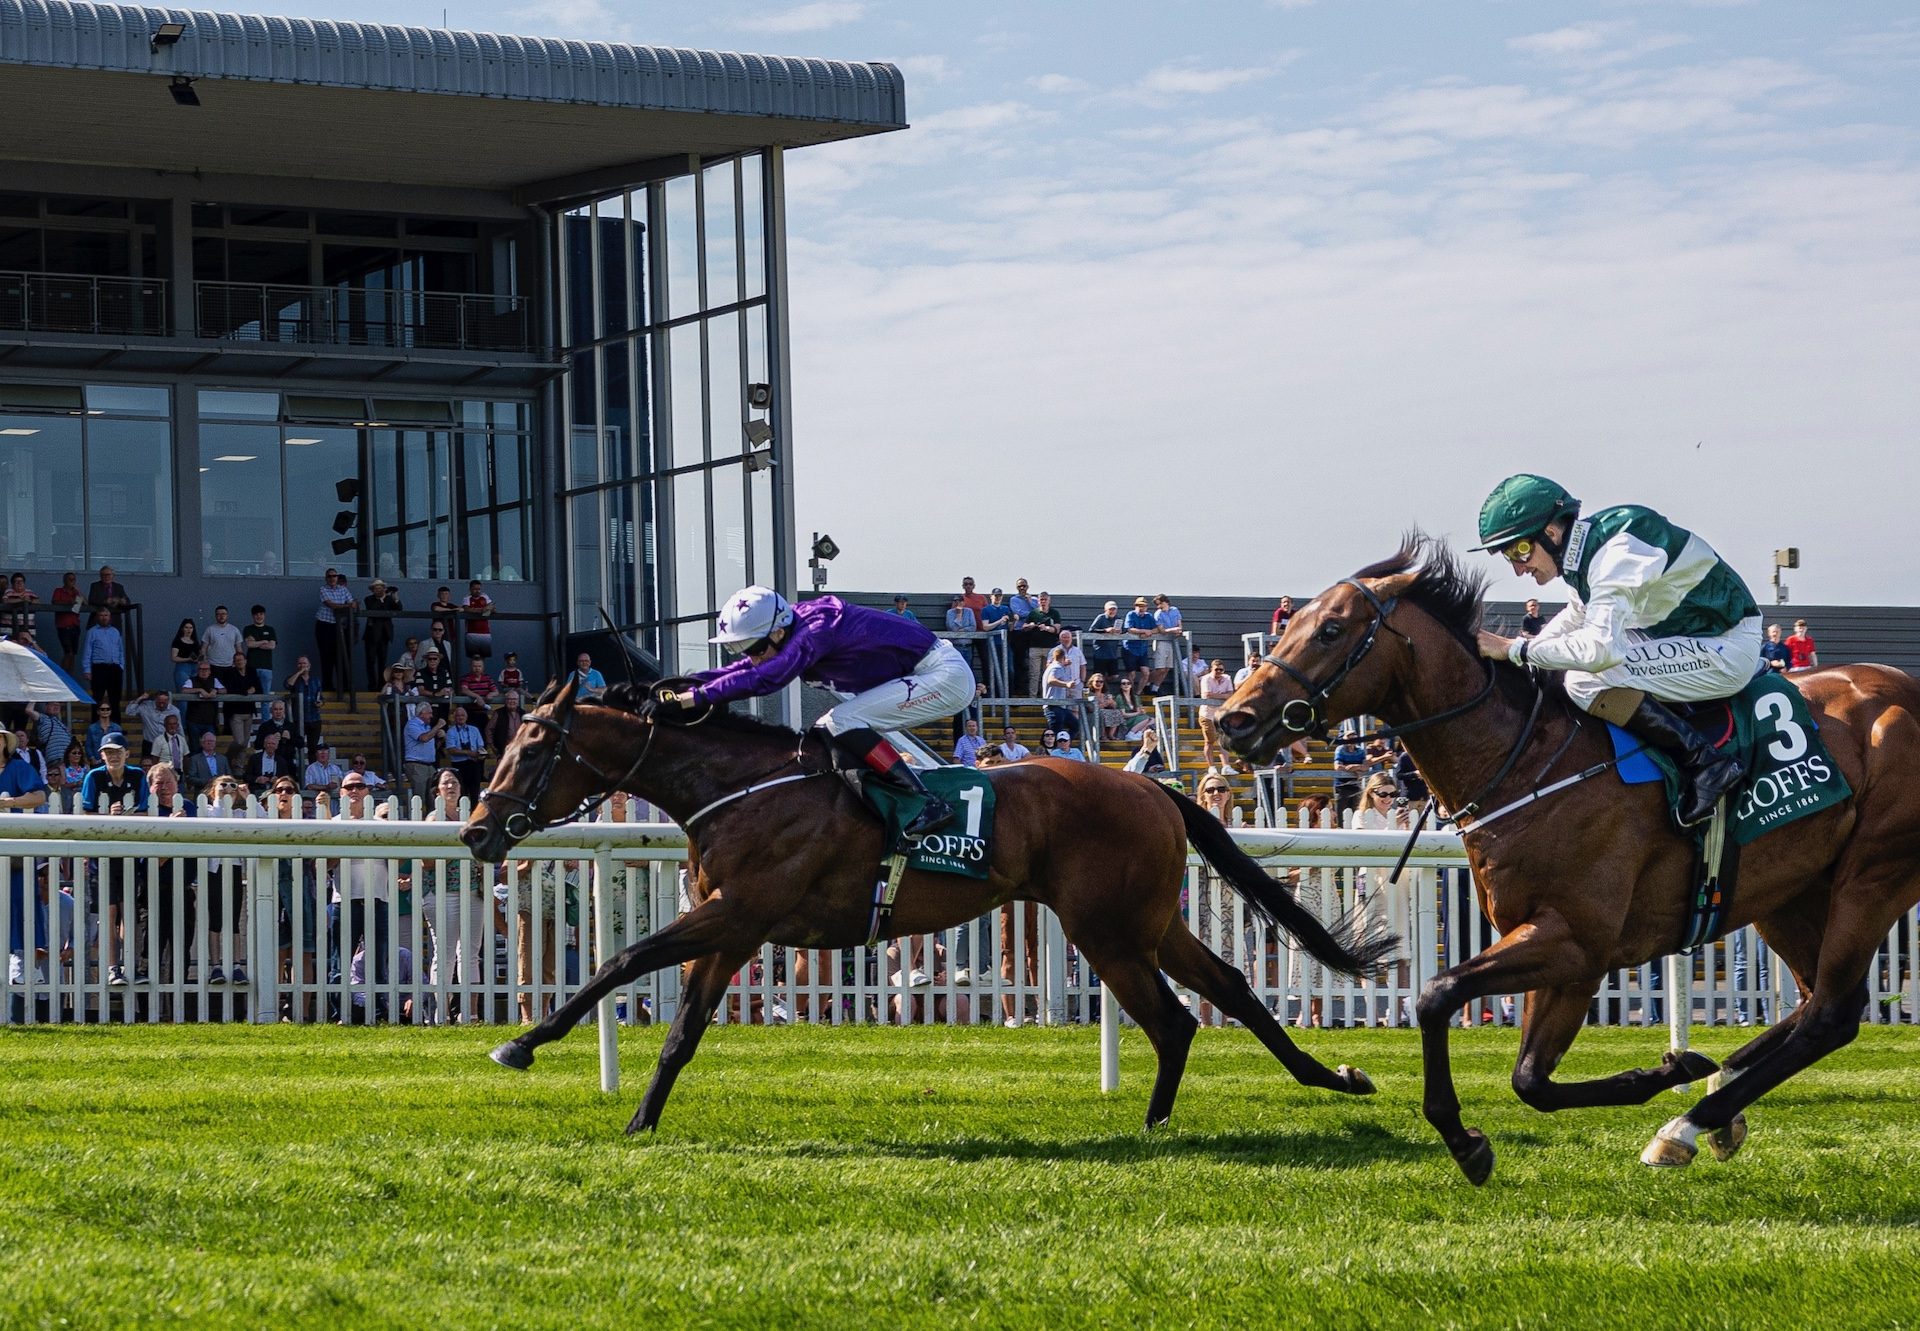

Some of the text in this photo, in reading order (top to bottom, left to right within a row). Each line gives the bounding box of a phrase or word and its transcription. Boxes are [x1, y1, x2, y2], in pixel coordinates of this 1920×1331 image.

[1755, 692, 1808, 761] 3
[960, 786, 984, 838] 1
[1758, 793, 1820, 825] SINCE 1866
[920, 855, 946, 865] SINCE
